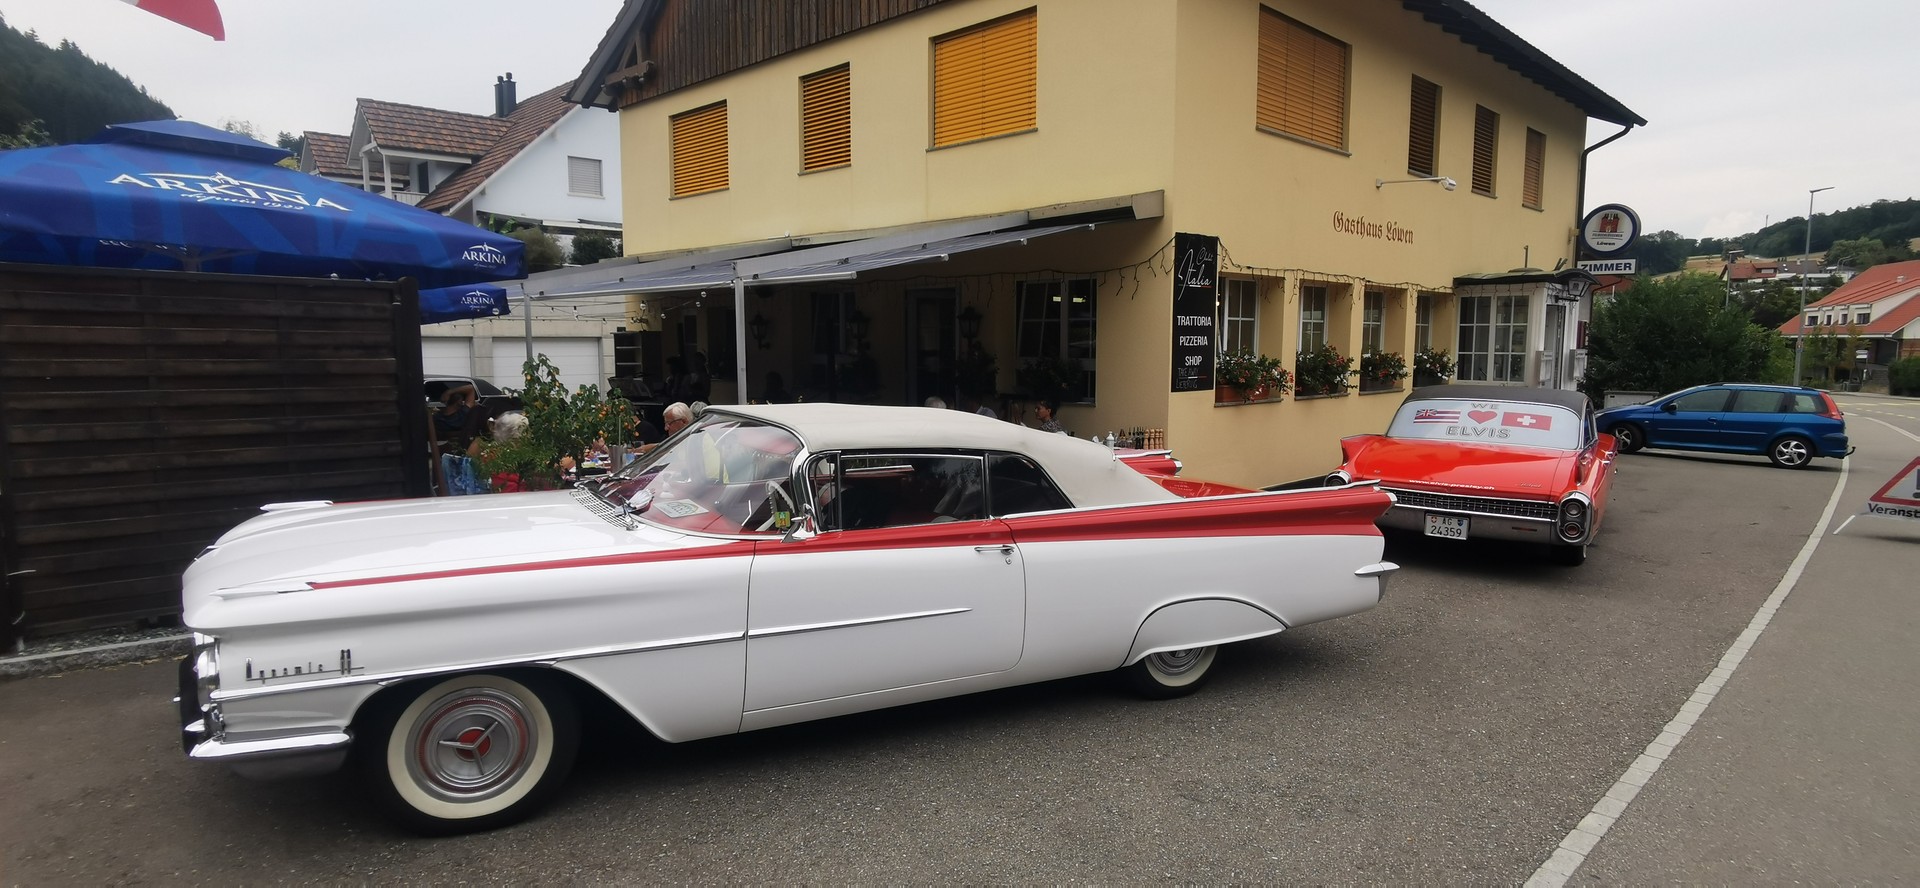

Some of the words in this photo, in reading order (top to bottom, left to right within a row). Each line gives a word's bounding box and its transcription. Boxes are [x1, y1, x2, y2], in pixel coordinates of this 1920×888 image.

[106, 173, 353, 211] ARKINA
[1333, 210, 1383, 239] Gasthaus
[1386, 220, 1413, 244] Löwen
[462, 250, 506, 265] ARKINA
[1581, 262, 1632, 272] ZIMMER
[1178, 248, 1212, 300] Italia
[461, 296, 495, 305] ARKINA
[1177, 315, 1212, 326] TRATTORIA
[1179, 335, 1208, 346] PIZZERIA
[1185, 355, 1202, 366] SHOP
[1445, 425, 1511, 439] ELVIS
[1409, 479, 1495, 490] www.elvis-presley.ch
[1442, 517, 1452, 526] AG
[1430, 525, 1462, 537] 24359
